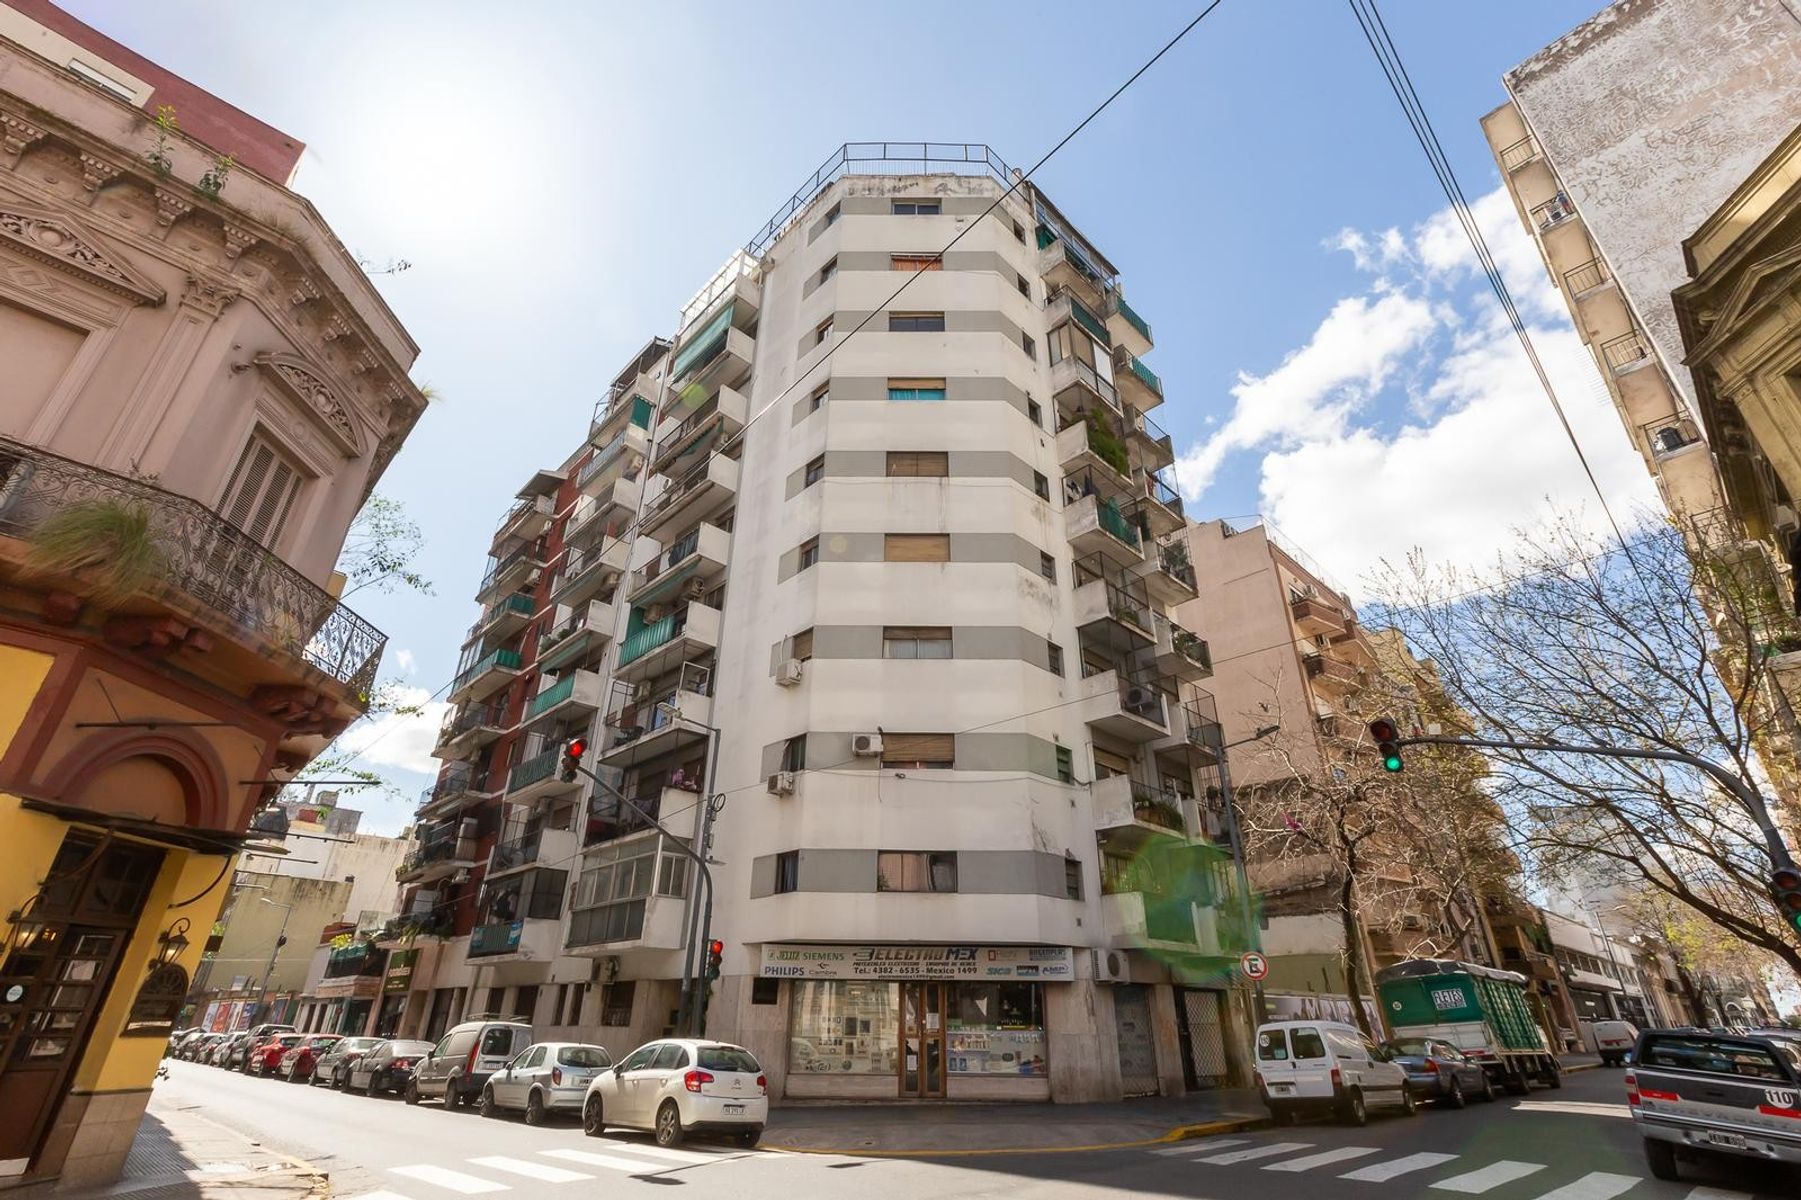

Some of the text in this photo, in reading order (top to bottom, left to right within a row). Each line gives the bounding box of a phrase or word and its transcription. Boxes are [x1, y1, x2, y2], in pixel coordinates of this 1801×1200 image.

[803, 952, 845, 961] SIEMENS
[764, 966, 805, 976] PHILIPS
[1767, 1089, 1793, 1104] 110
